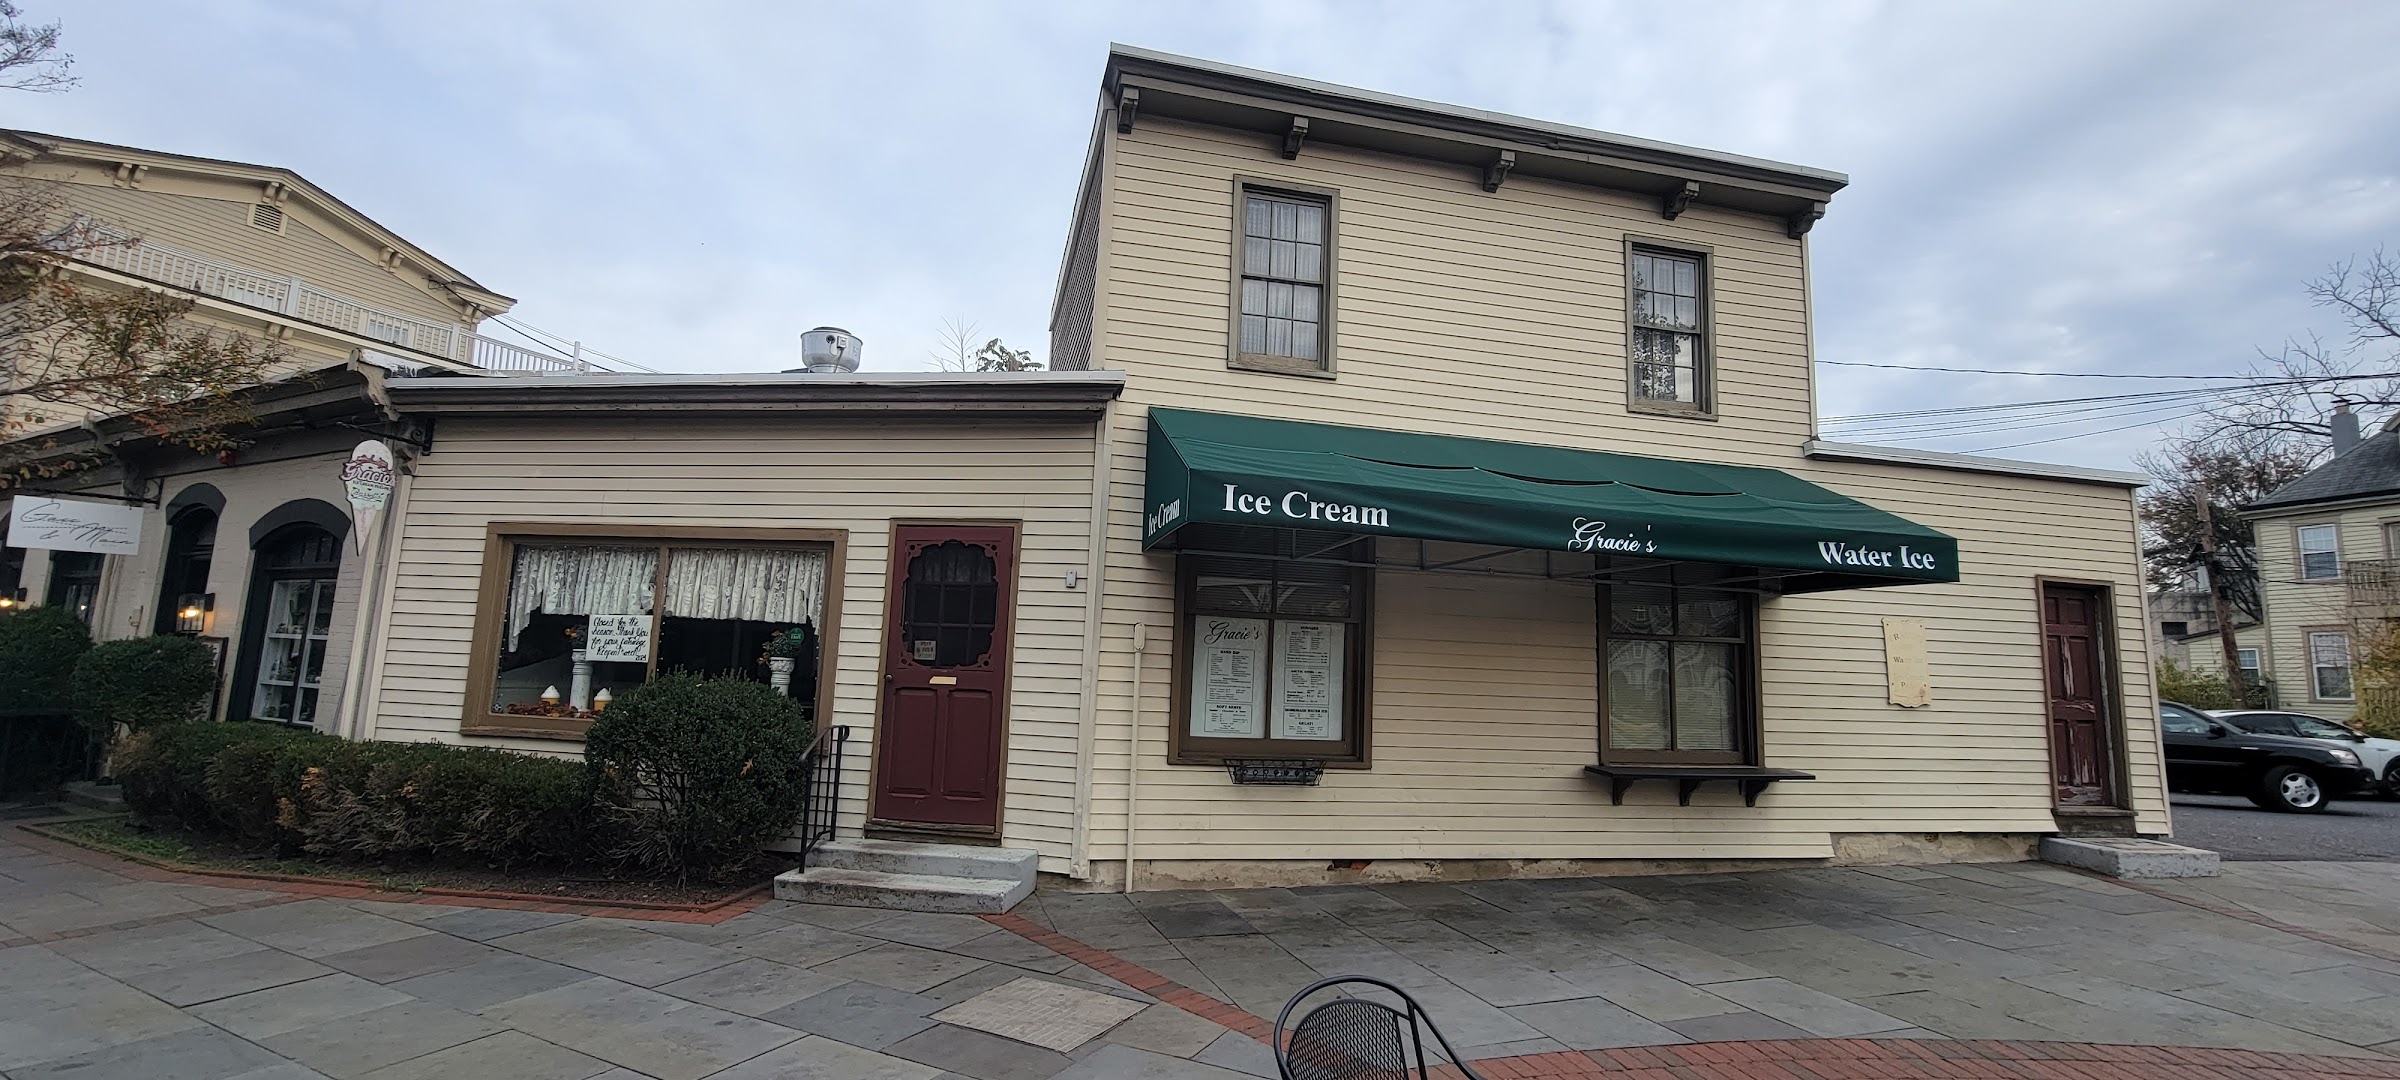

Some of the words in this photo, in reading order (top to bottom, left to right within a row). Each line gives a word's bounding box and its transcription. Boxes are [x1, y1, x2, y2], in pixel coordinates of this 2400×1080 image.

[1147, 511, 1157, 538] Ice
[1157, 498, 1180, 528] Cream
[1222, 483, 1271, 515] Ice
[1281, 490, 1390, 528] Cream
[1568, 517, 1657, 552] Gracie's
[1817, 541, 1893, 568] Water
[1899, 545, 1936, 570] Ice
[593, 616, 614, 627] Closed
[617, 616, 627, 630] for
[628, 617, 640, 627] the
[616, 627, 634, 636] Thank
[1203, 620, 1260, 645] Gracie's
[591, 636, 602, 649] for
[604, 638, 619, 650] your
